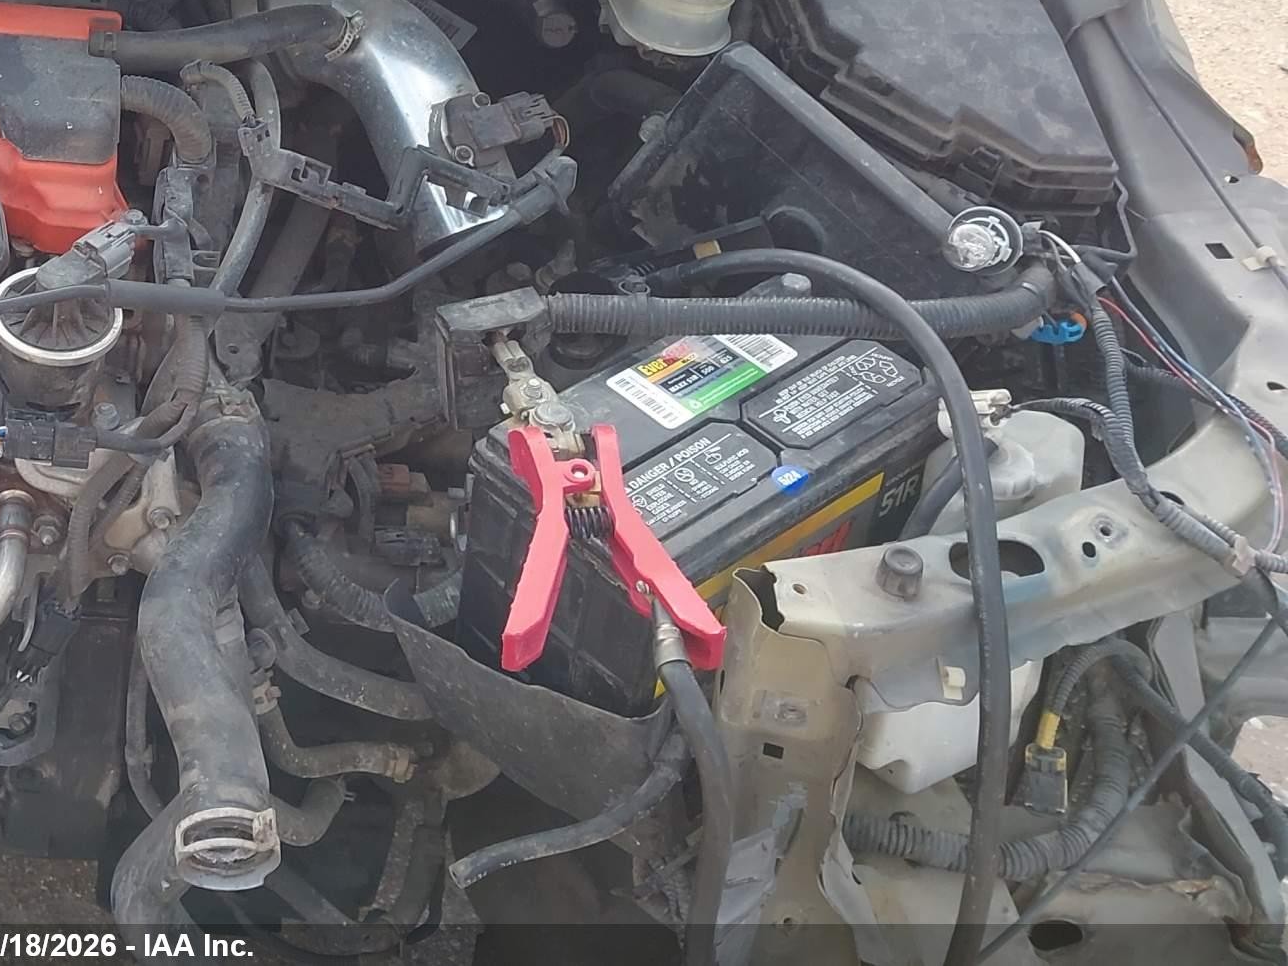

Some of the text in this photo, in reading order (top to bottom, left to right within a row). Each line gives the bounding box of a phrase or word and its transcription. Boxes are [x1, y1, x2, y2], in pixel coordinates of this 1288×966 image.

[627, 462, 671, 488] DANGER
[672, 437, 712, 461] POISON
[879, 474, 920, 517] 51R
